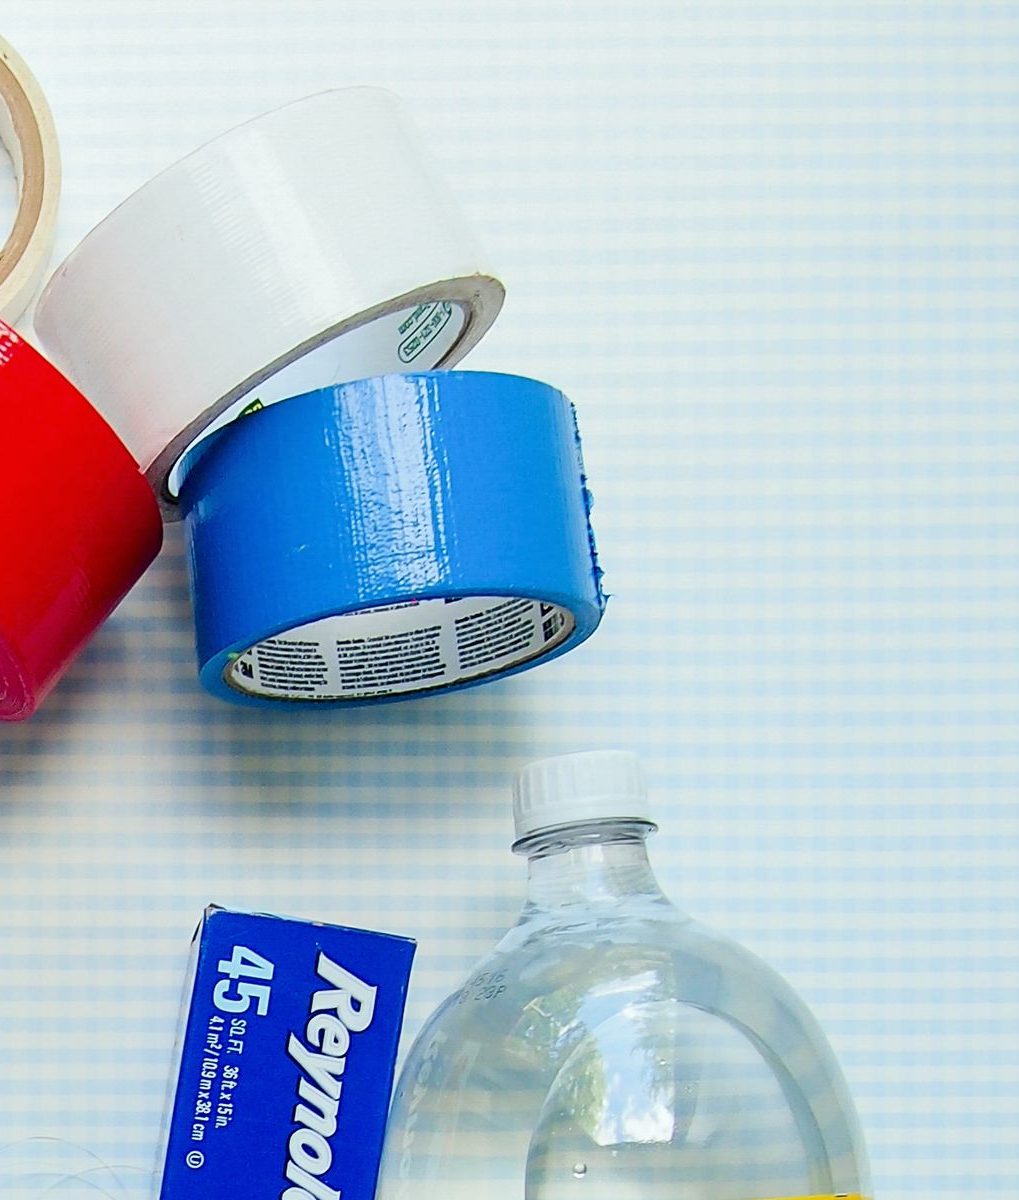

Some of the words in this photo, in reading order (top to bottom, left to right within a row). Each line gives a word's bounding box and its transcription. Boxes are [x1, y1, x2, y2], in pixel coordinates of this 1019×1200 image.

[212, 945, 275, 1016] 45
[226, 1039, 244, 1055] FT.
[222, 1065, 239, 1080] 36
[199, 1079, 212, 1091] m
[197, 1091, 210, 1099] x
[219, 1093, 232, 1101] x
[217, 1102, 233, 1116] 15
[191, 1123, 205, 1141] cm
